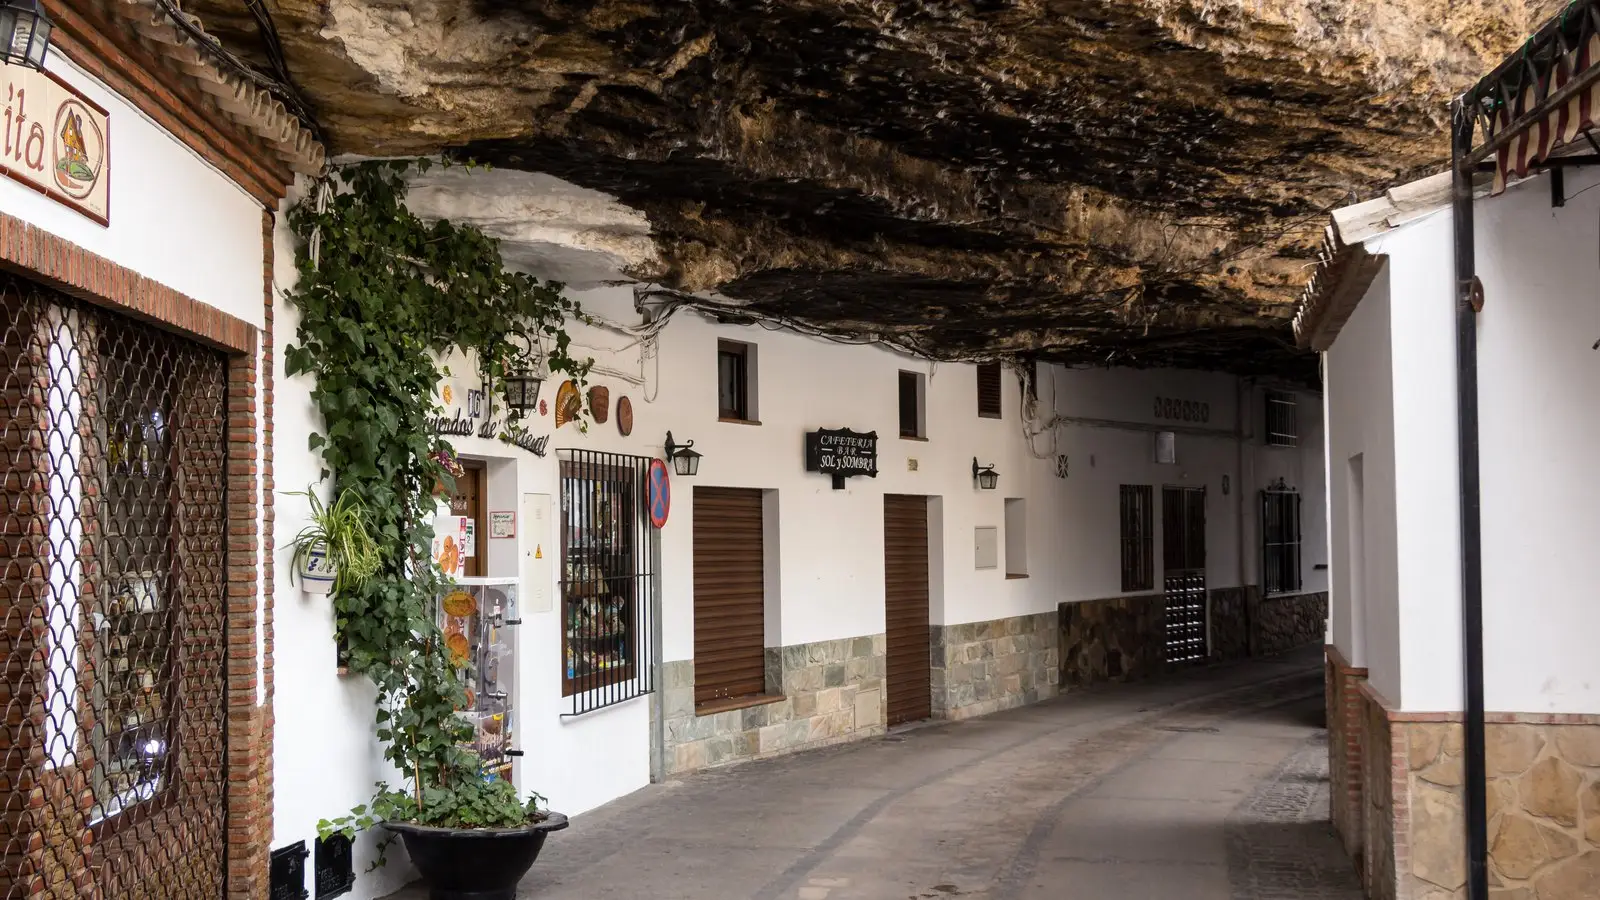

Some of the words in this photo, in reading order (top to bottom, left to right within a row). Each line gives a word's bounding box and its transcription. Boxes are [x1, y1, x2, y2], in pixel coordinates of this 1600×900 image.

[468, 392, 480, 416] 16
[836, 446, 857, 456] BAR
[820, 455, 836, 468] SOL
[836, 458, 841, 470] y
[841, 455, 873, 471] SOMBRA
